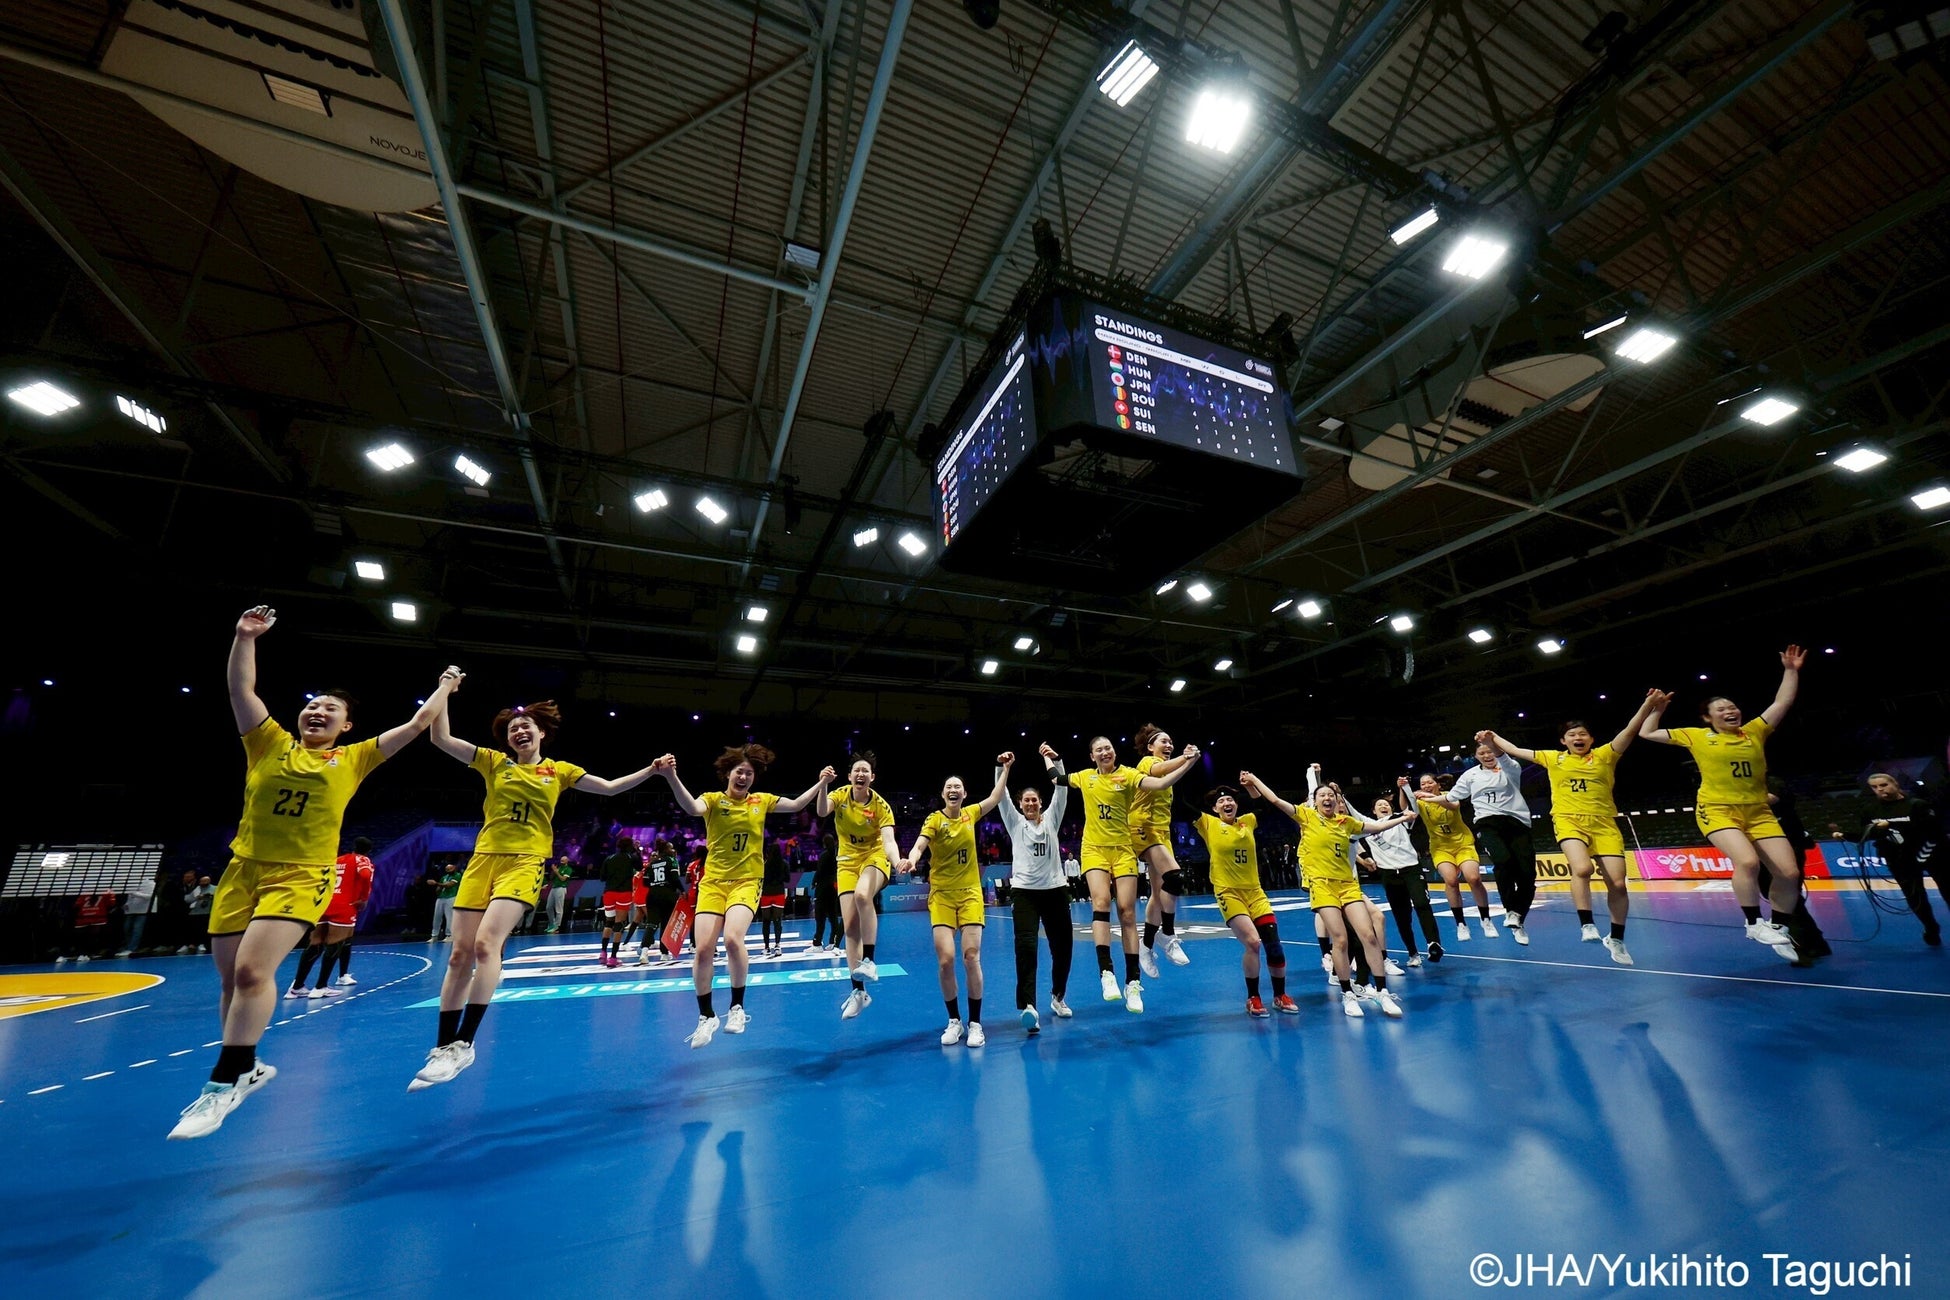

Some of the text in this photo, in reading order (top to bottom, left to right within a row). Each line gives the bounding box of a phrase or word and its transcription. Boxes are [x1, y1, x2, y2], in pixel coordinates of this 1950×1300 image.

[1095, 314, 1163, 345] STANDINGS
[1126, 351, 1148, 366] DEN
[1128, 365, 1151, 380] HUN
[1130, 379, 1151, 393] JPN
[1132, 392, 1155, 407] ROU
[1133, 406, 1151, 419] SUI
[1135, 420, 1156, 434] SEN
[937, 429, 963, 473] STANDINGS
[1730, 761, 1752, 777] 20
[1570, 779, 1587, 792] 24
[273, 788, 309, 817] 23
[511, 801, 530, 823] 51
[1098, 804, 1112, 820] 32
[732, 833, 748, 852] 37
[1033, 842, 1046, 857] 30
[1234, 849, 1247, 863] 55
[1335, 843, 1341, 858] 5
[653, 866, 665, 882] 16
